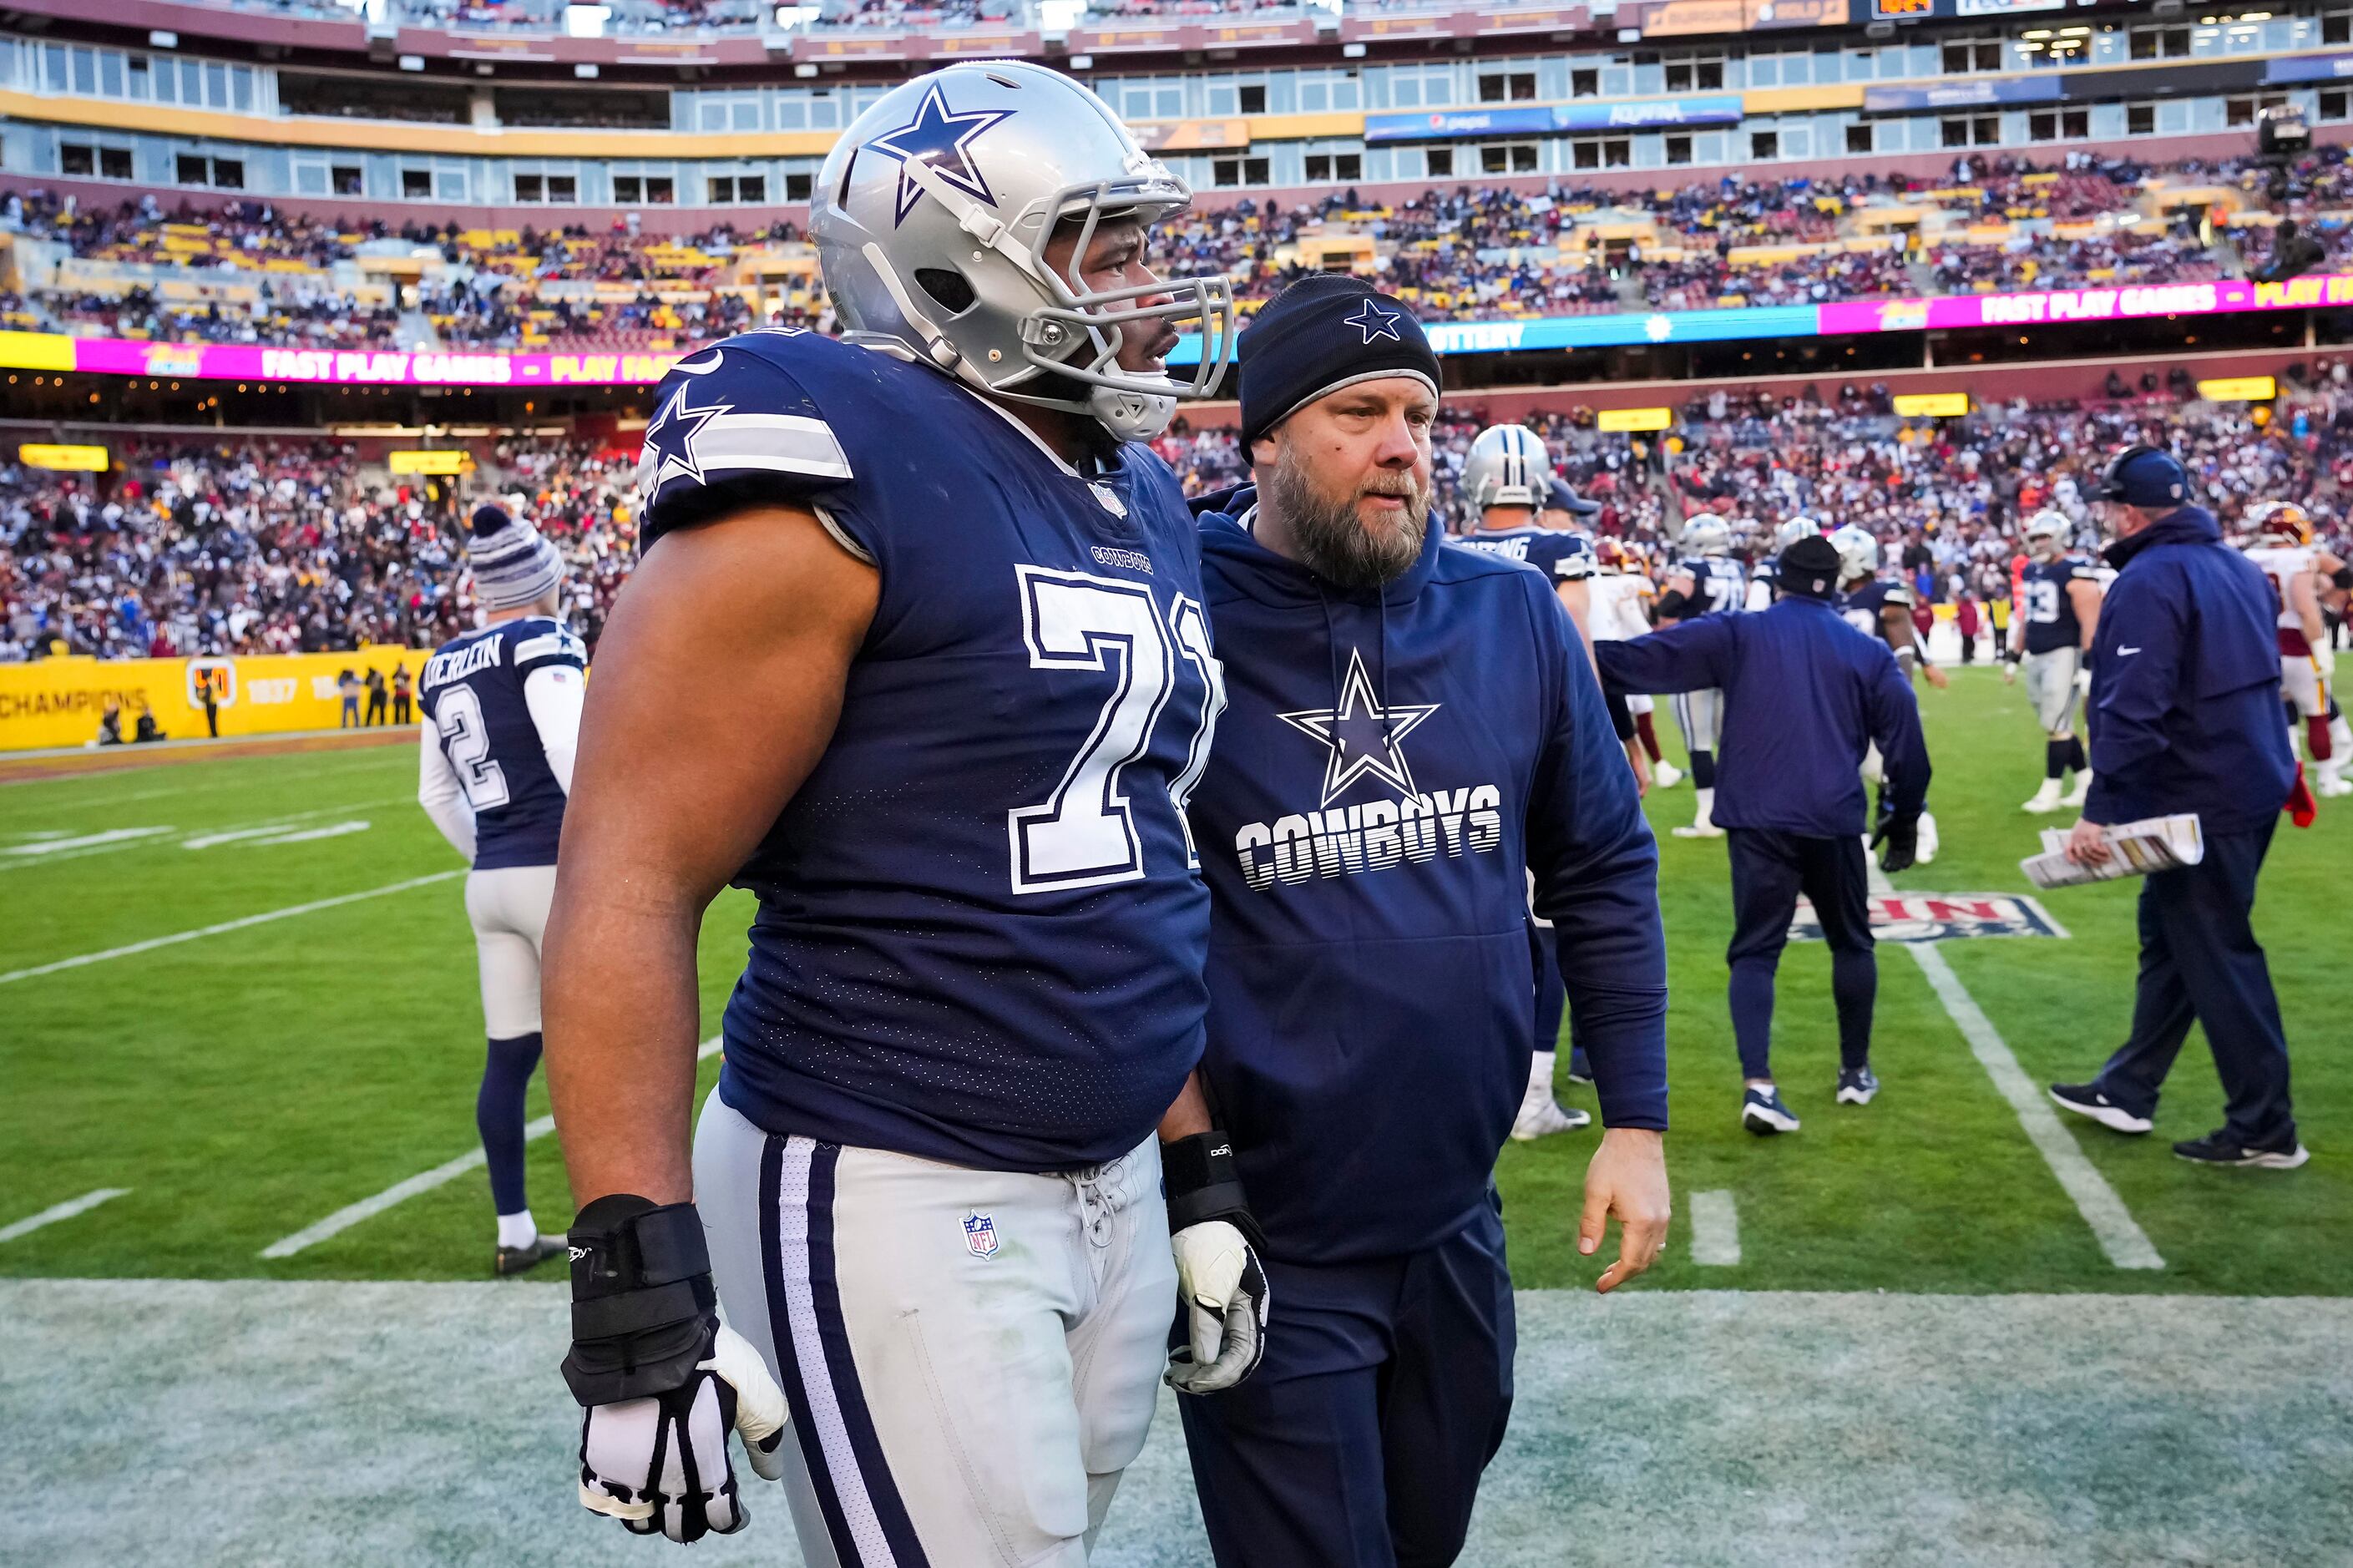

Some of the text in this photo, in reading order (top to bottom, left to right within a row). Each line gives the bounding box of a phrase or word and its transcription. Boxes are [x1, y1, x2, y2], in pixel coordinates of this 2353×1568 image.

[1981, 295, 2048, 322] FAST
[2050, 291, 2118, 319] PLAY
[2120, 284, 2216, 315] GAMES
[1420, 323, 1523, 351] OTTERY
[262, 350, 332, 378] FAST
[337, 353, 408, 381] PLAY
[413, 356, 511, 382] GAMES
[551, 357, 616, 382] PLAY
[1090, 545, 1154, 575] COWBOYS
[0, 688, 149, 717] CHAMPIONS
[435, 682, 510, 813] 2
[1235, 784, 1500, 892] COWBOYS
[970, 1232, 995, 1251] NFL
